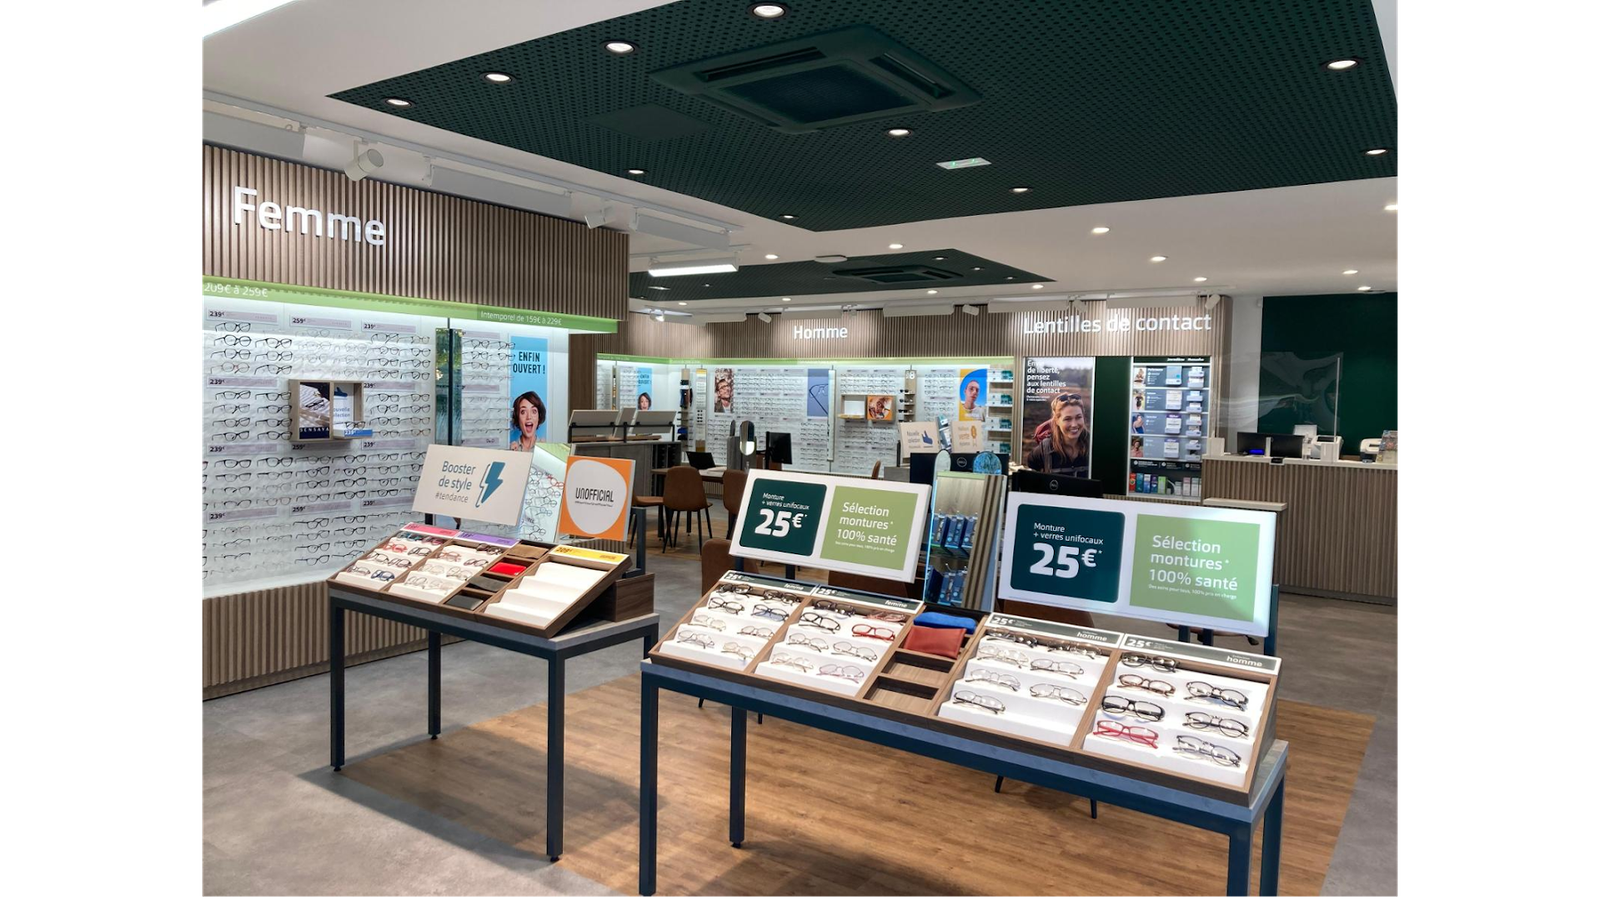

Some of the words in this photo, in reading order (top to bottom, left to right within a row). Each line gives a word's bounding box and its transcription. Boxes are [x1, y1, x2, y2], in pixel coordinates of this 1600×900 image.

[234, 186, 385, 246] Femme
[242, 286, 269, 298] 259€
[481, 311, 516, 322] Intemporel
[516, 314, 524, 322] de
[526, 315, 540, 324] 159€
[1024, 314, 1101, 334] Lentilles
[1106, 314, 1130, 332] de
[1136, 314, 1212, 331] contact
[794, 326, 848, 340] Homme
[518, 351, 540, 362] ENFIN
[512, 362, 542, 374] OUVERT
[1027, 366, 1036, 374] de
[1026, 374, 1050, 382] pensez
[442, 460, 476, 475] Booster
[438, 476, 450, 488] de
[451, 478, 472, 492] style
[435, 491, 468, 504] #tendance
[575, 487, 614, 502] UNOFFICIAL
[762, 492, 785, 500] Monture
[783, 502, 810, 510] unifocaux
[842, 502, 890, 517] Sélection
[1034, 522, 1066, 532] Monture
[837, 528, 866, 542] 100%
[867, 534, 897, 546] santé
[1040, 532, 1064, 540] verres
[1065, 534, 1104, 545] unifocaux
[1152, 534, 1221, 554] Sélection
[1149, 569, 1192, 585] 100%
[1195, 576, 1238, 591] santé
[884, 600, 908, 608] femme
[992, 616, 1016, 626] 25€
[1077, 632, 1108, 642] homme
[1127, 639, 1153, 648] 25€
[1226, 656, 1263, 668] homme
